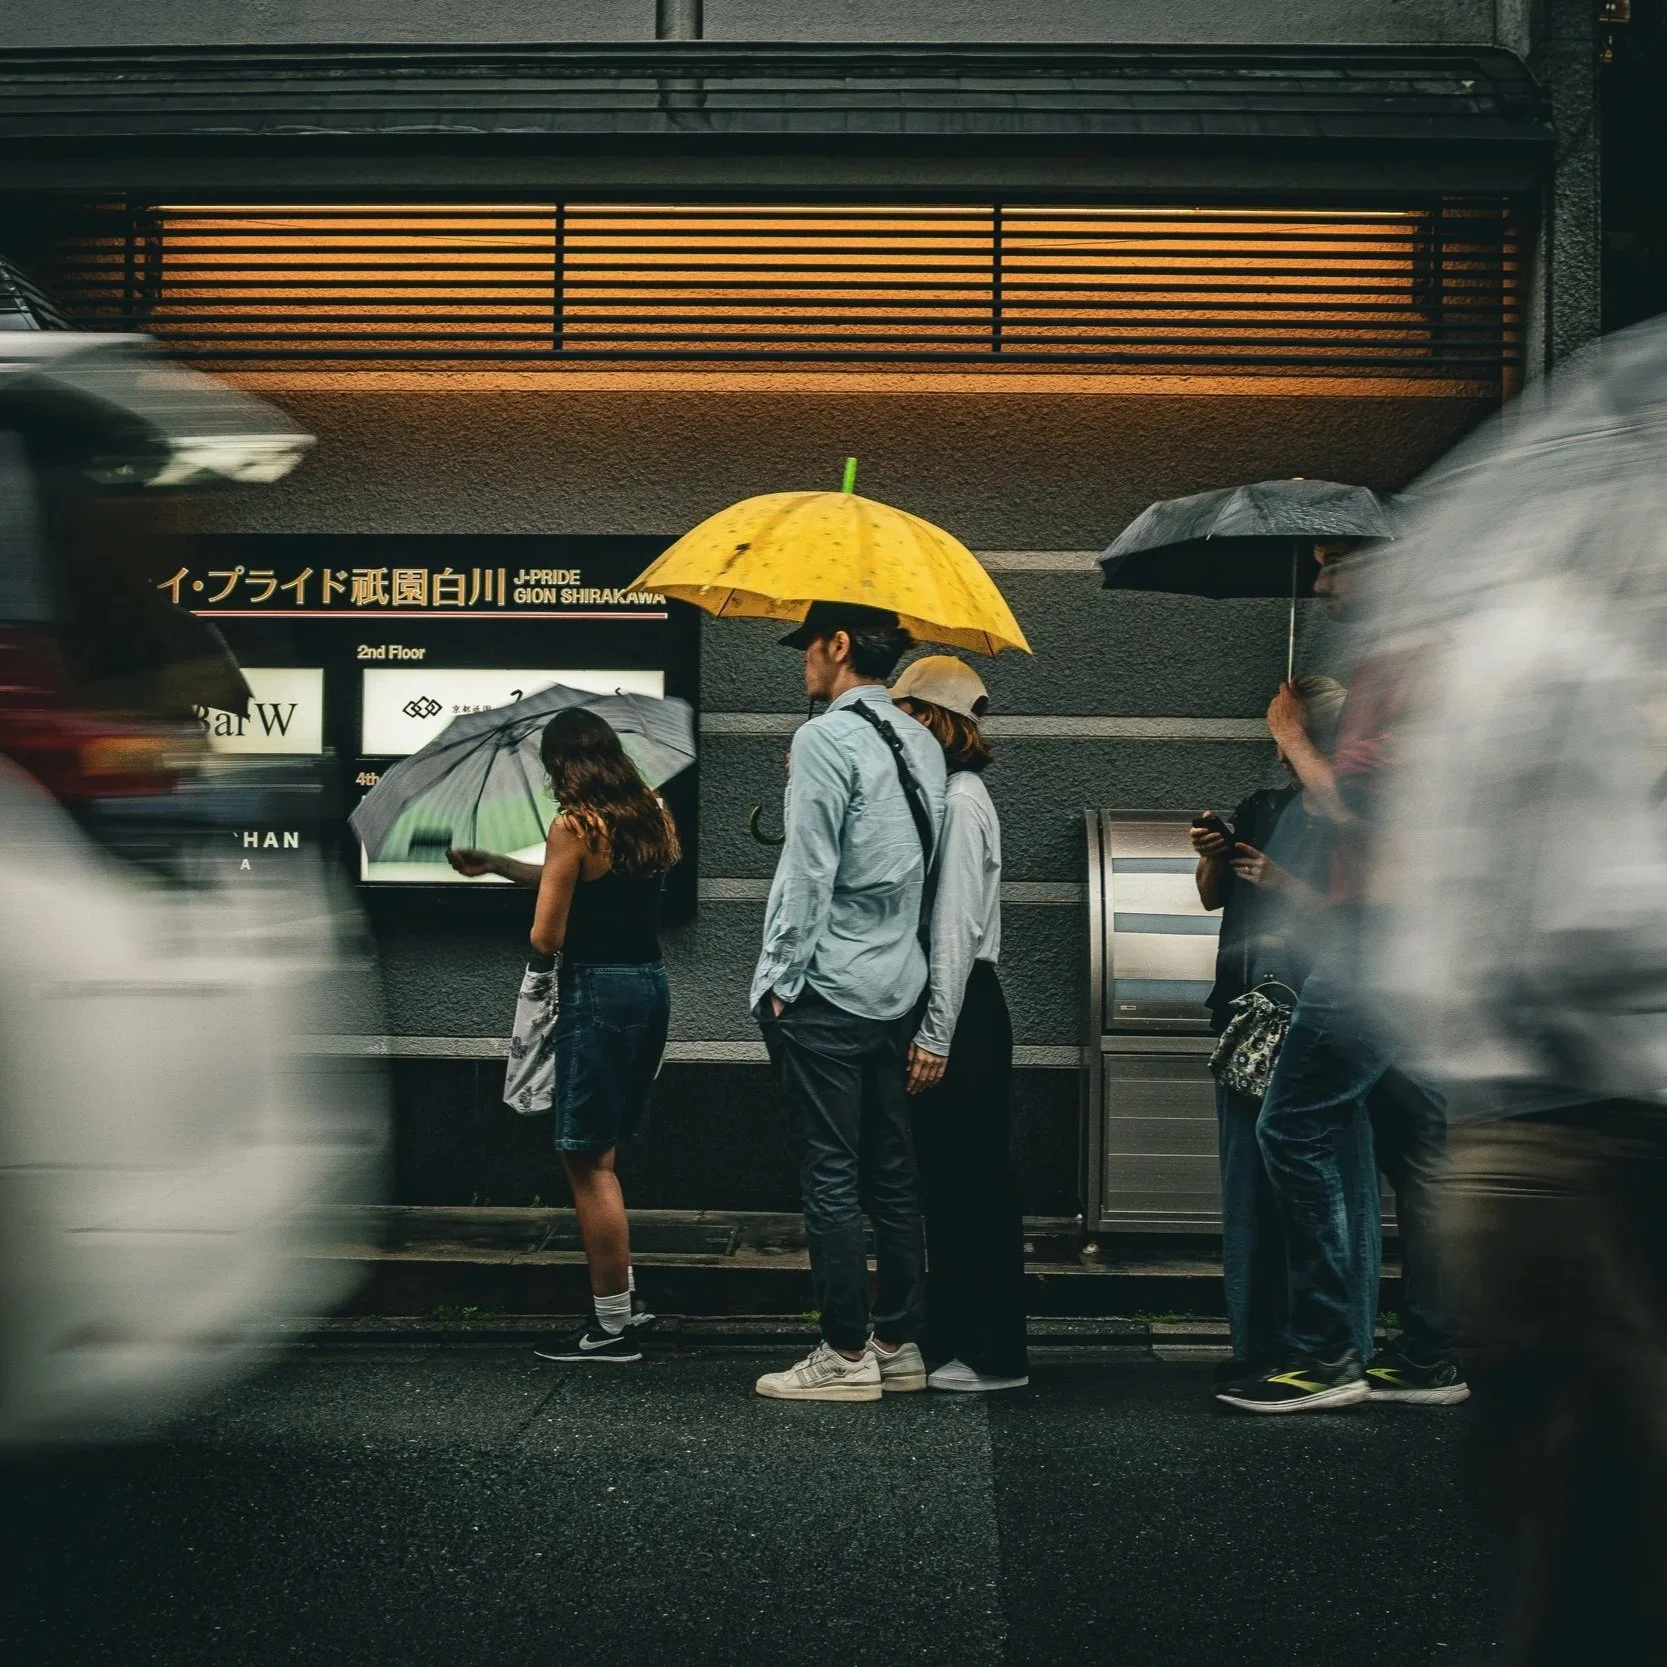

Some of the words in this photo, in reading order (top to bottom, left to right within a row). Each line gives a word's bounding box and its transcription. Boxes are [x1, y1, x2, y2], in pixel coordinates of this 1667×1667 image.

[513, 569, 581, 586] J-PRIDE
[513, 588, 557, 604] GION
[561, 588, 667, 605] SHIRAKAWA
[357, 644, 386, 660] 2nd
[388, 644, 426, 660] Floor
[254, 703, 298, 736] W
[355, 772, 381, 786] 4th
